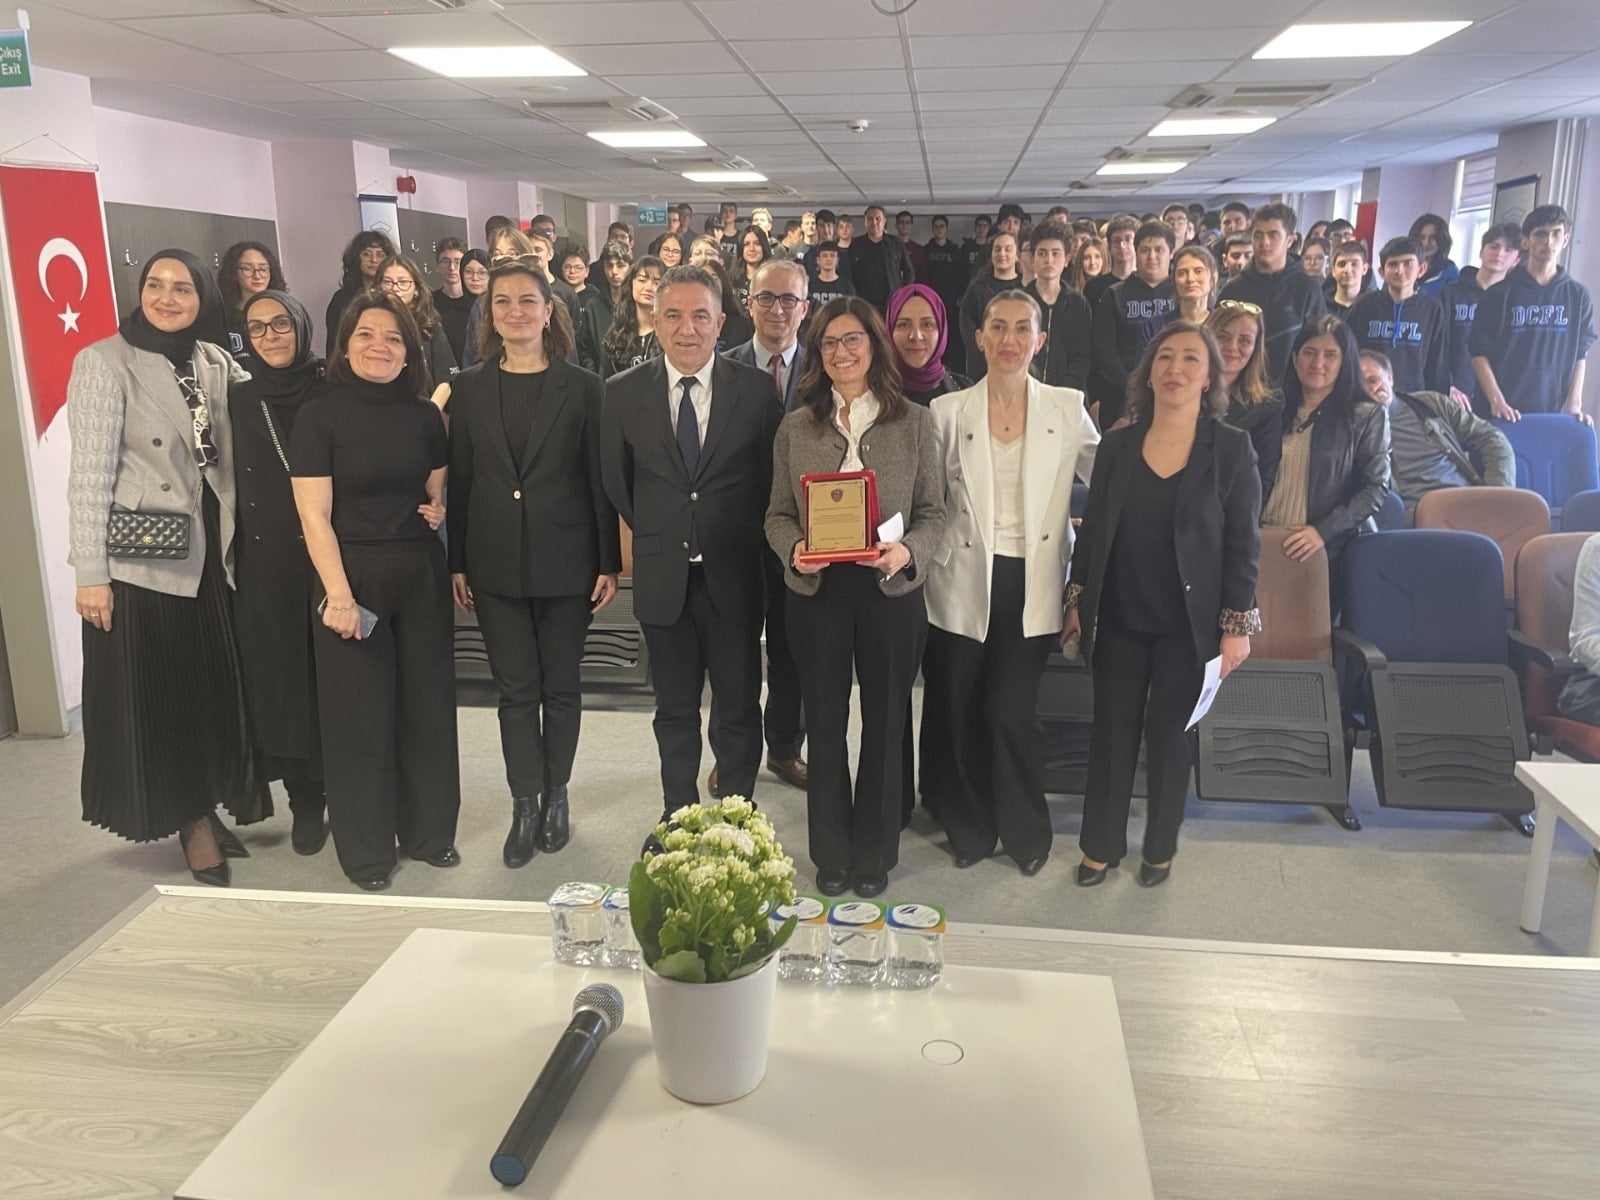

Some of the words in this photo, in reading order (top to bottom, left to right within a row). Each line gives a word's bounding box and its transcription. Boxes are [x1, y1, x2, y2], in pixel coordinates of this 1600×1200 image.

[1, 63, 21, 75] Exit
[1511, 305, 1568, 326] DCFL
[1368, 320, 1422, 341] DCFL
